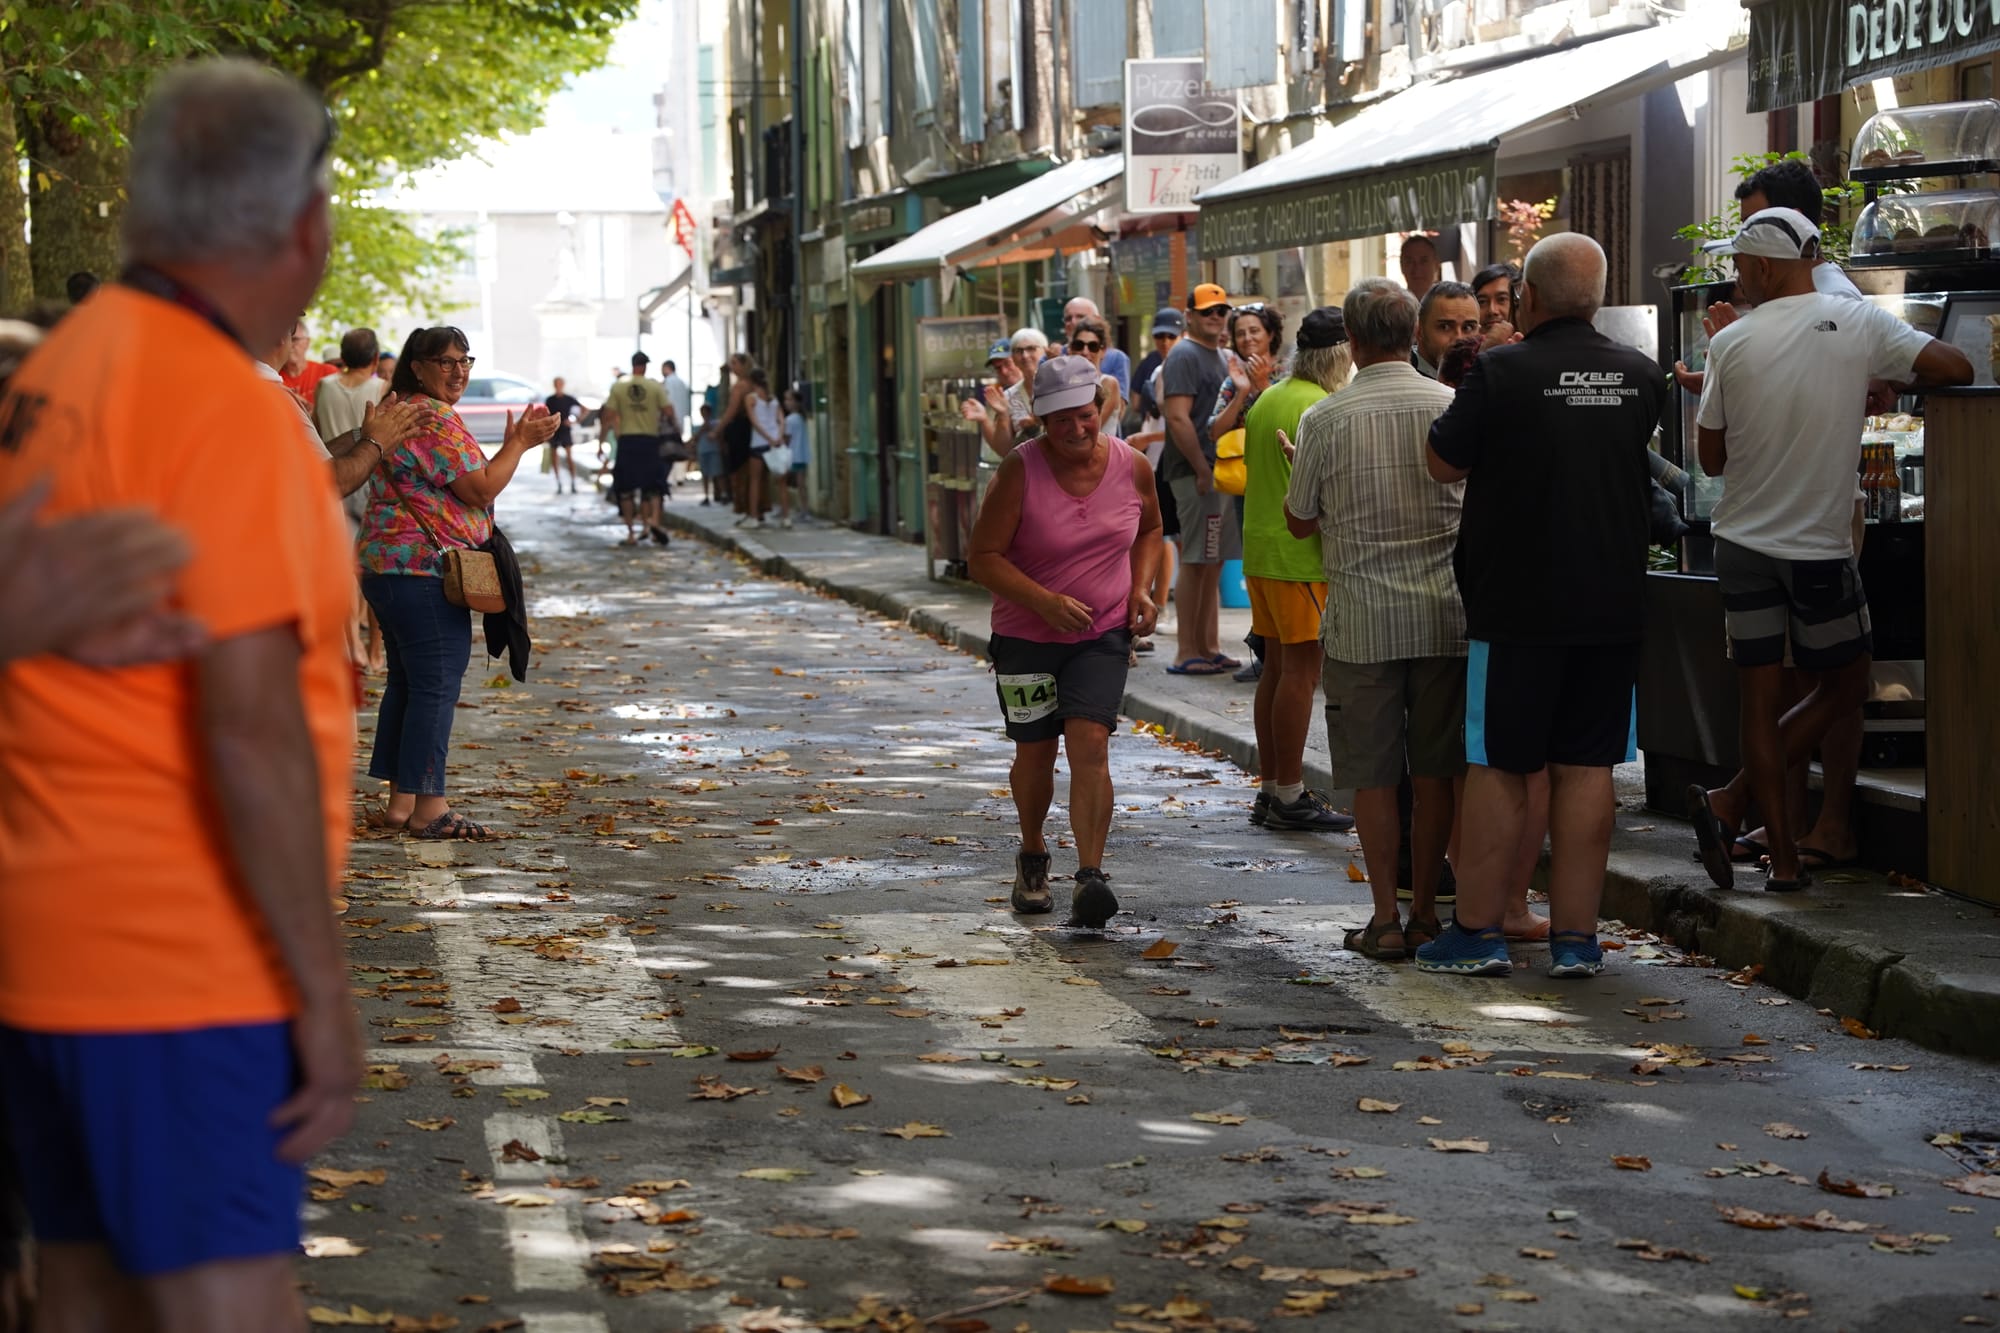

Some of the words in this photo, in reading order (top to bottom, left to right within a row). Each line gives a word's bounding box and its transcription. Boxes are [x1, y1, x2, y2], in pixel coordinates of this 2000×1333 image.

[1184, 163, 1221, 181] Petit
[1203, 207, 1258, 252] BOUCHERIE
[1264, 193, 1340, 242] CHARCUTERIE
[1347, 179, 1413, 231] MAISON
[1544, 388, 1597, 396] CLIMATISATION
